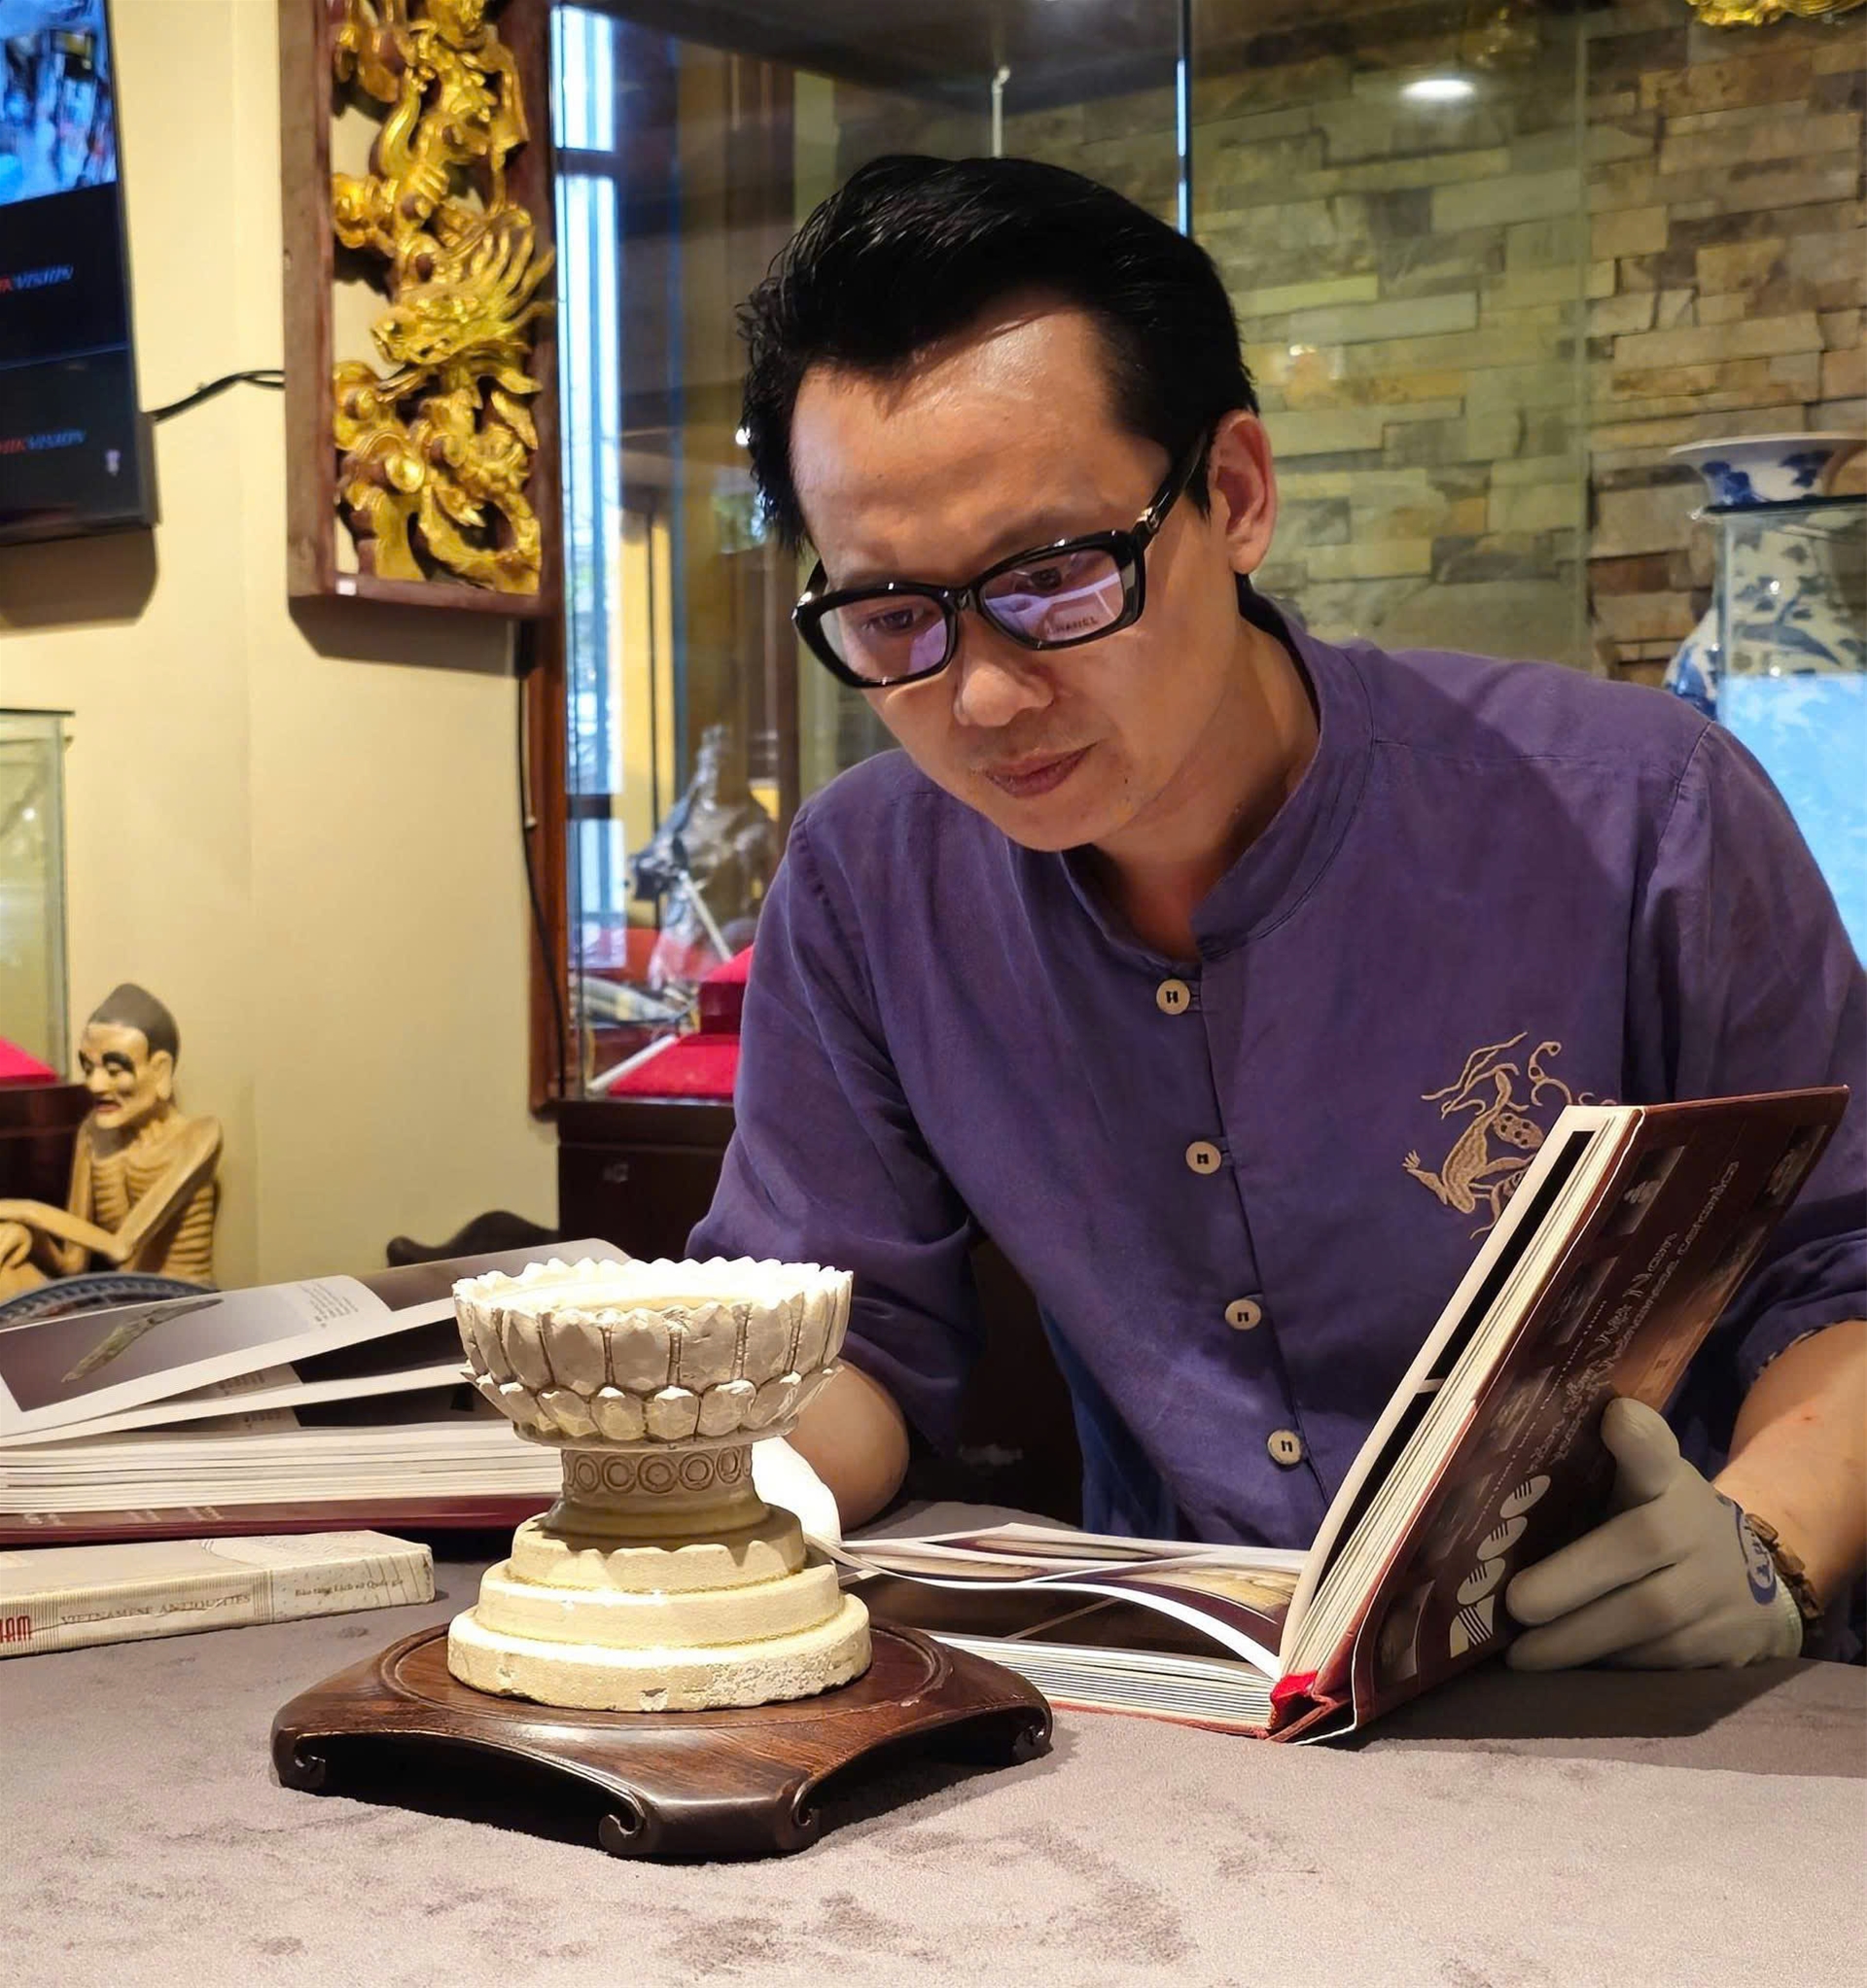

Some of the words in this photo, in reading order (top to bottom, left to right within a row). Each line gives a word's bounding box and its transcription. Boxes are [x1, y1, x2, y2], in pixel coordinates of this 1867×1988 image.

[1677, 1161, 1740, 1256] ceramics
[1450, 1474, 1550, 1657] 2000
[1622, 1232, 1678, 1298] Nam
[0, 1615, 33, 1644] AM
